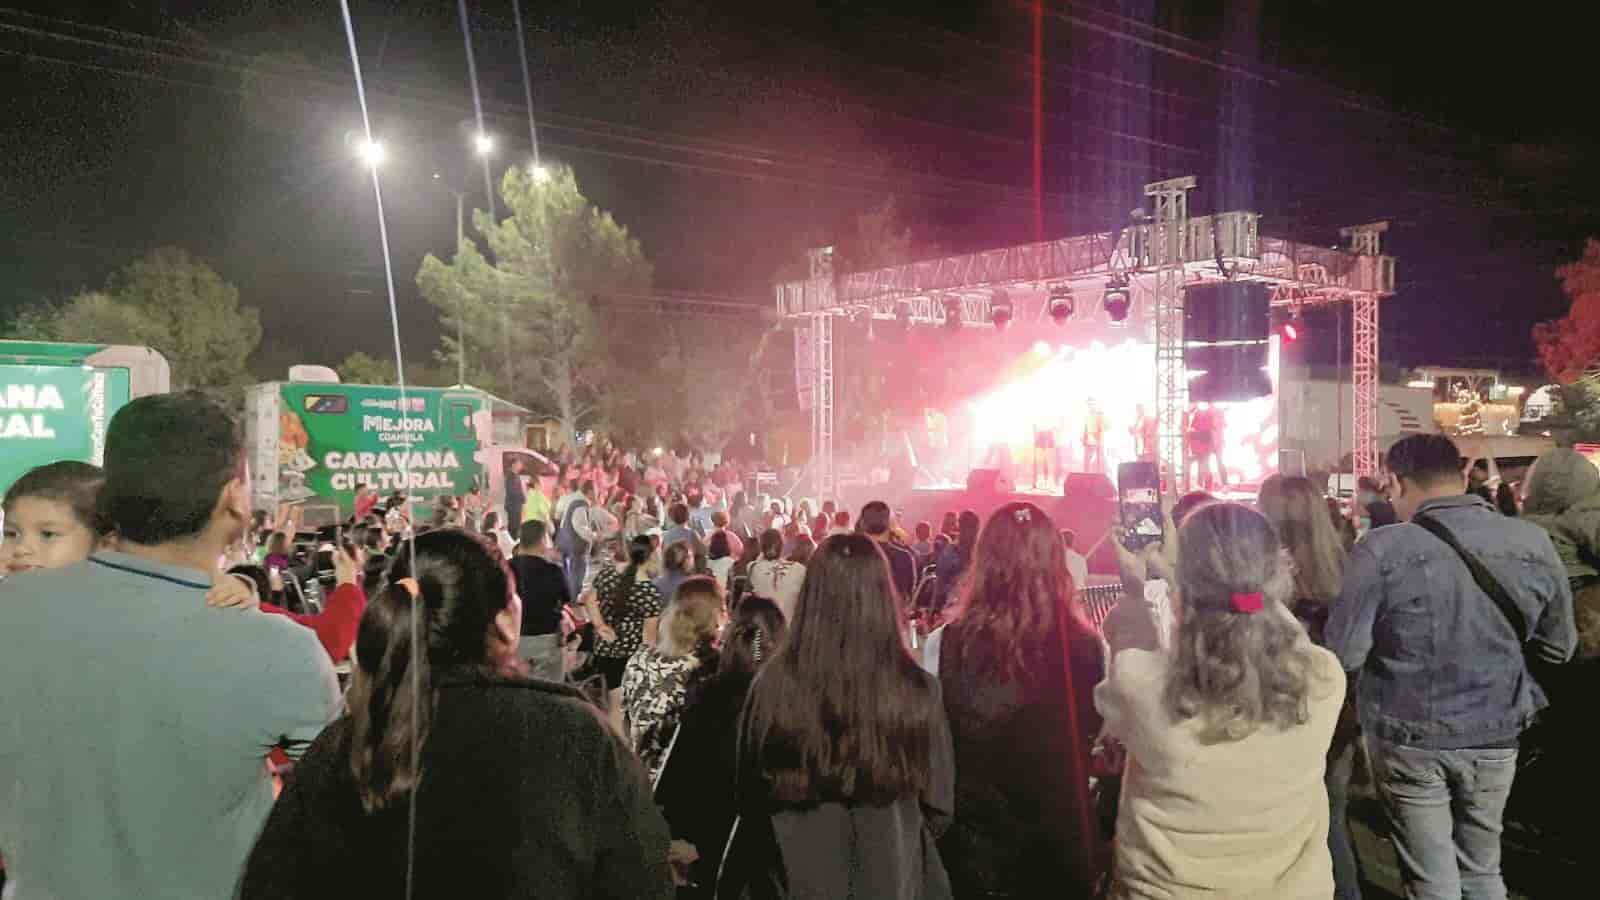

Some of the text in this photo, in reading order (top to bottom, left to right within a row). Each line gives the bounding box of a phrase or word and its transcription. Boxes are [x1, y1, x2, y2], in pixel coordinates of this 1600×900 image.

[0, 383, 64, 409] NA
[363, 415, 434, 432] MEJORA
[325, 451, 460, 469] CARAVANA
[330, 471, 455, 490] CULTURAL
